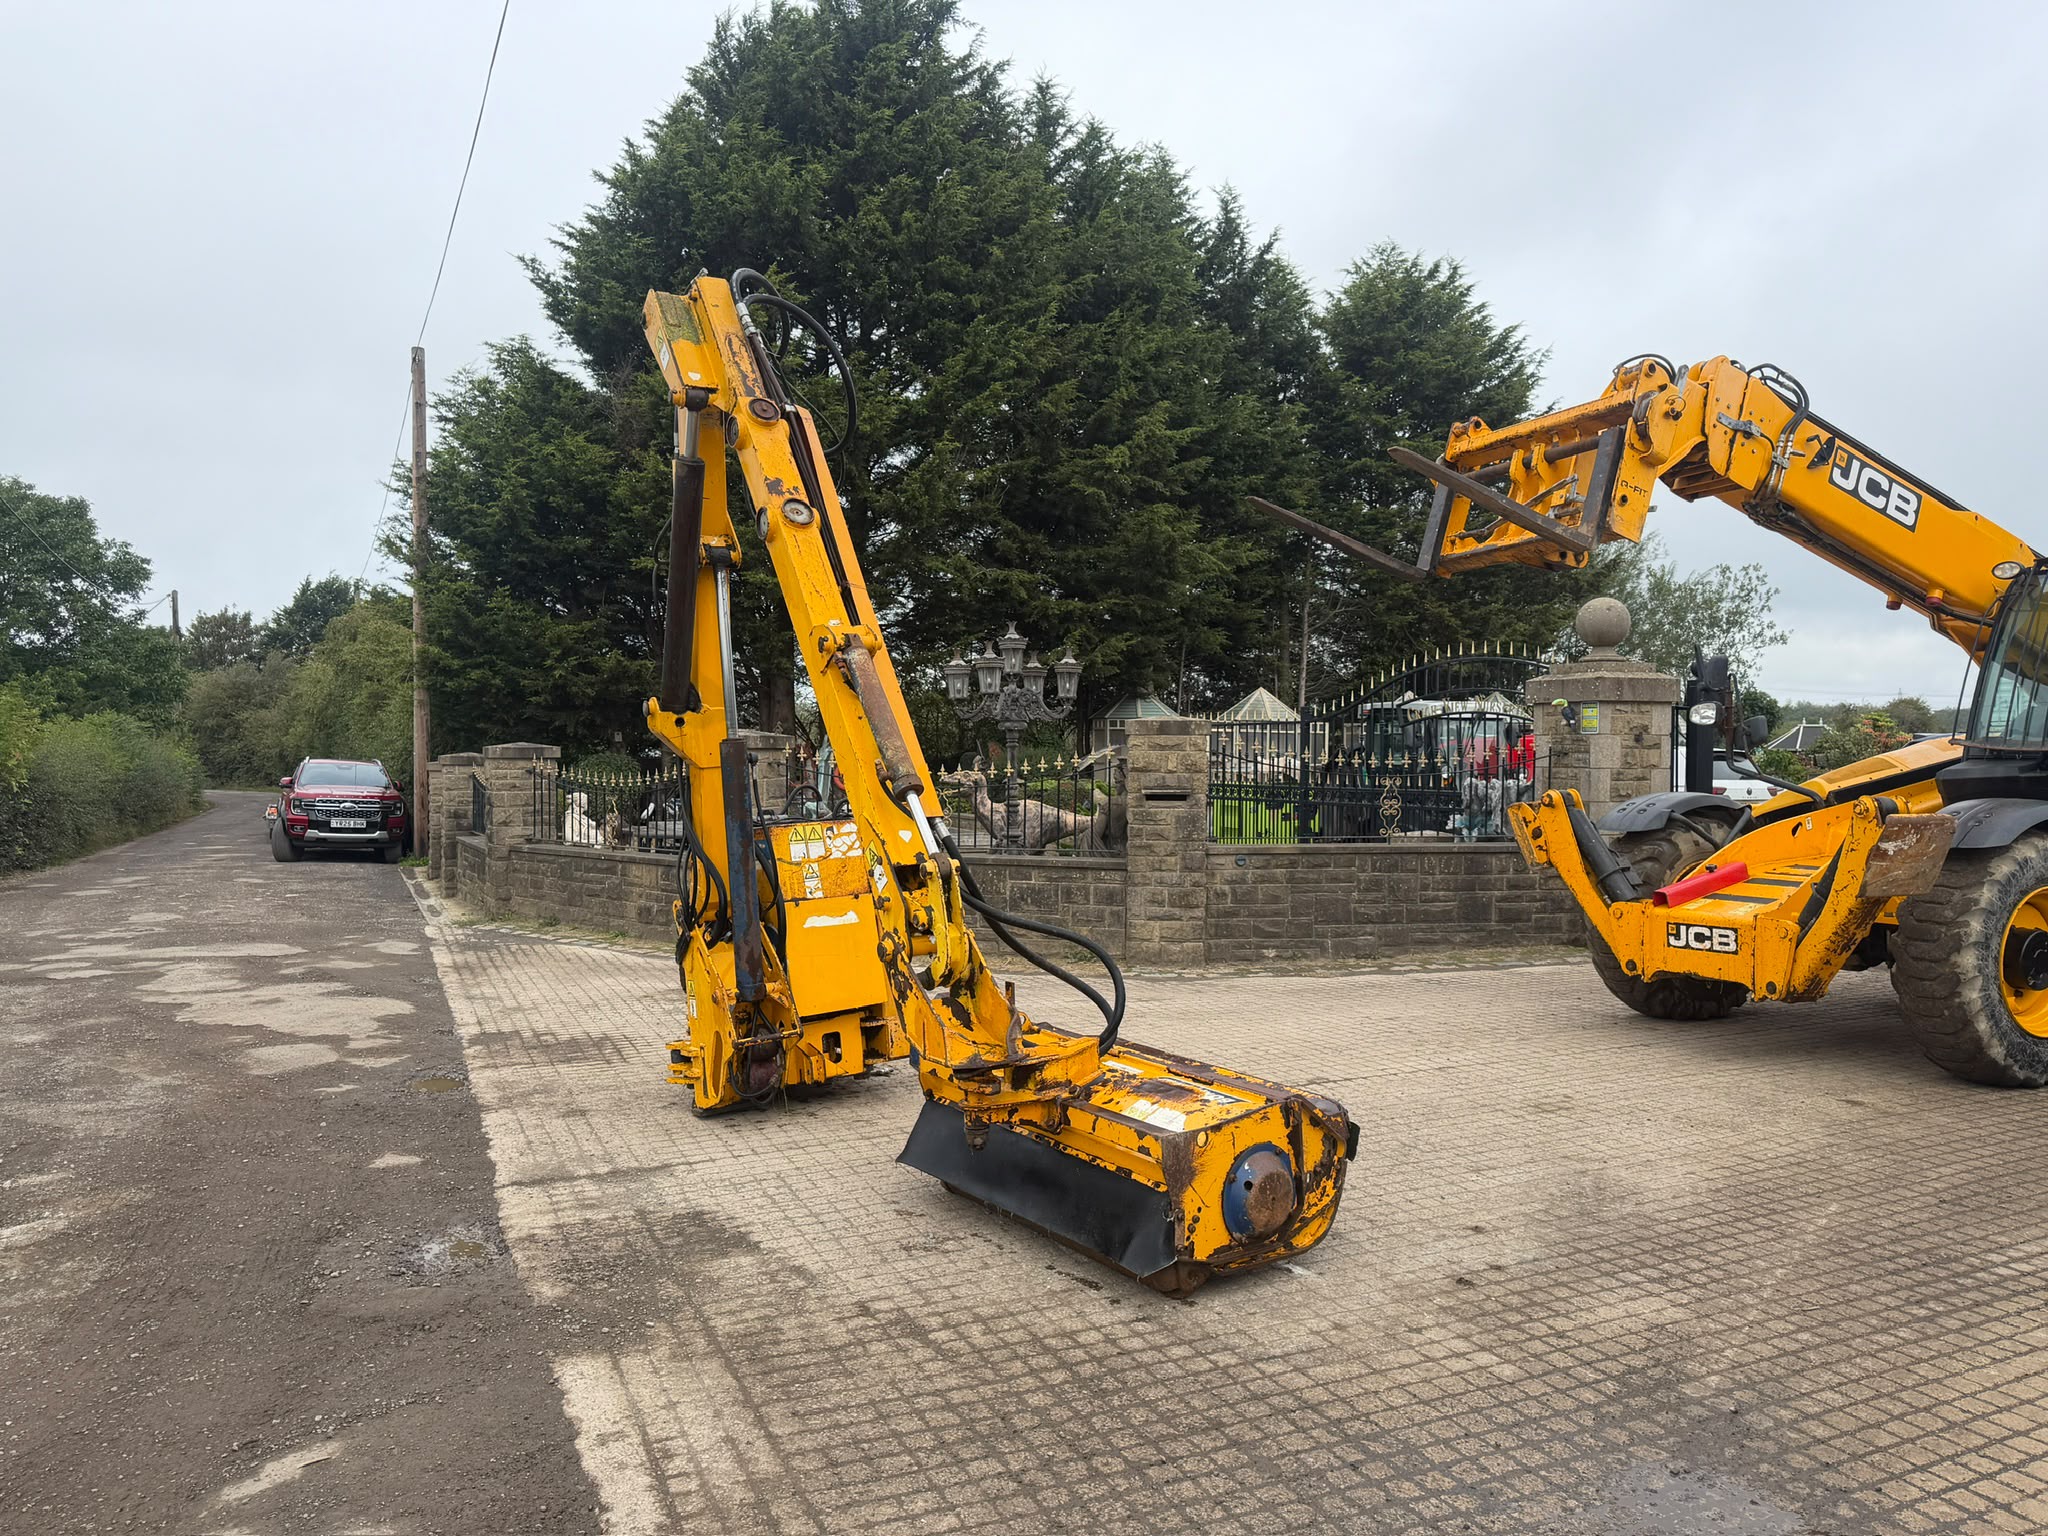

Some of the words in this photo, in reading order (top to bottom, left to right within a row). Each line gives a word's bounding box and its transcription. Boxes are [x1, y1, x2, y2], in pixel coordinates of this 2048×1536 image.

[1620, 479, 1649, 498] Q-FIT
[1832, 458, 1919, 527] JCB
[1668, 924, 1737, 953] JCB
